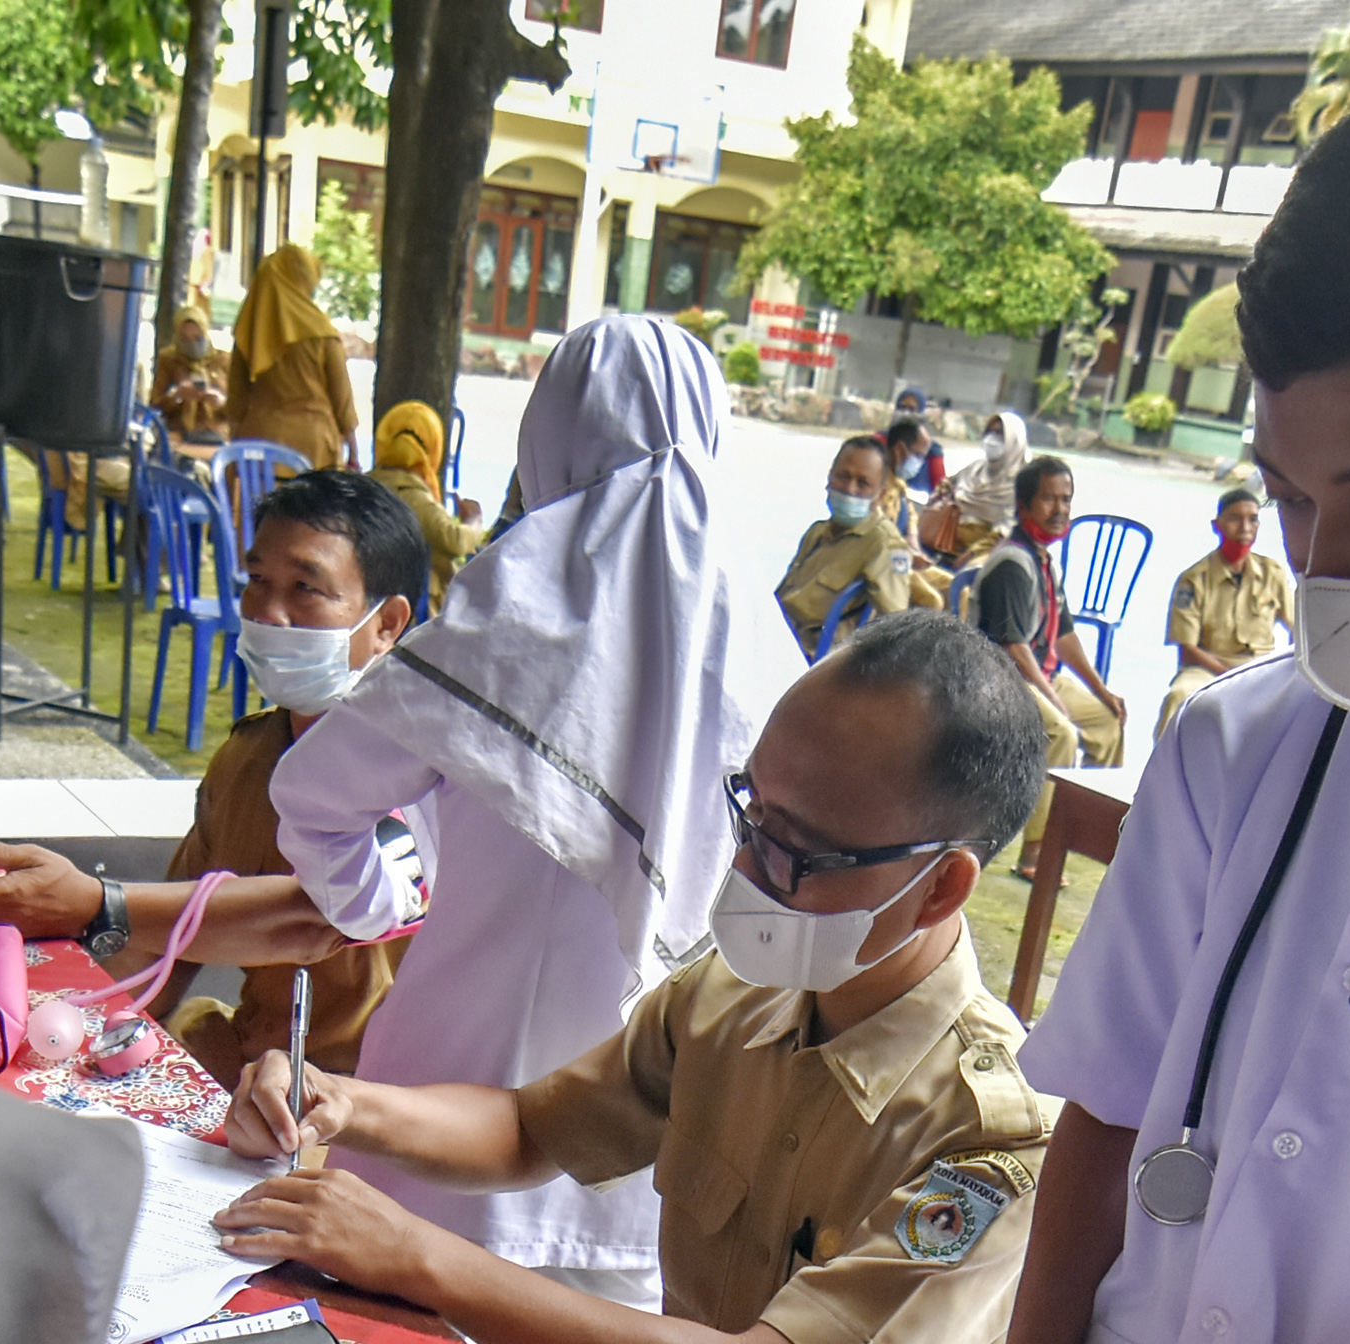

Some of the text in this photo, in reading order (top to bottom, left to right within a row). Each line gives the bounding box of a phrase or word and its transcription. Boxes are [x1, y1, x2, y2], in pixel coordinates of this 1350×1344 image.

[934, 1165, 1005, 1206] KOTA MATARAM
[995, 1153, 1032, 1191] MATARAM
